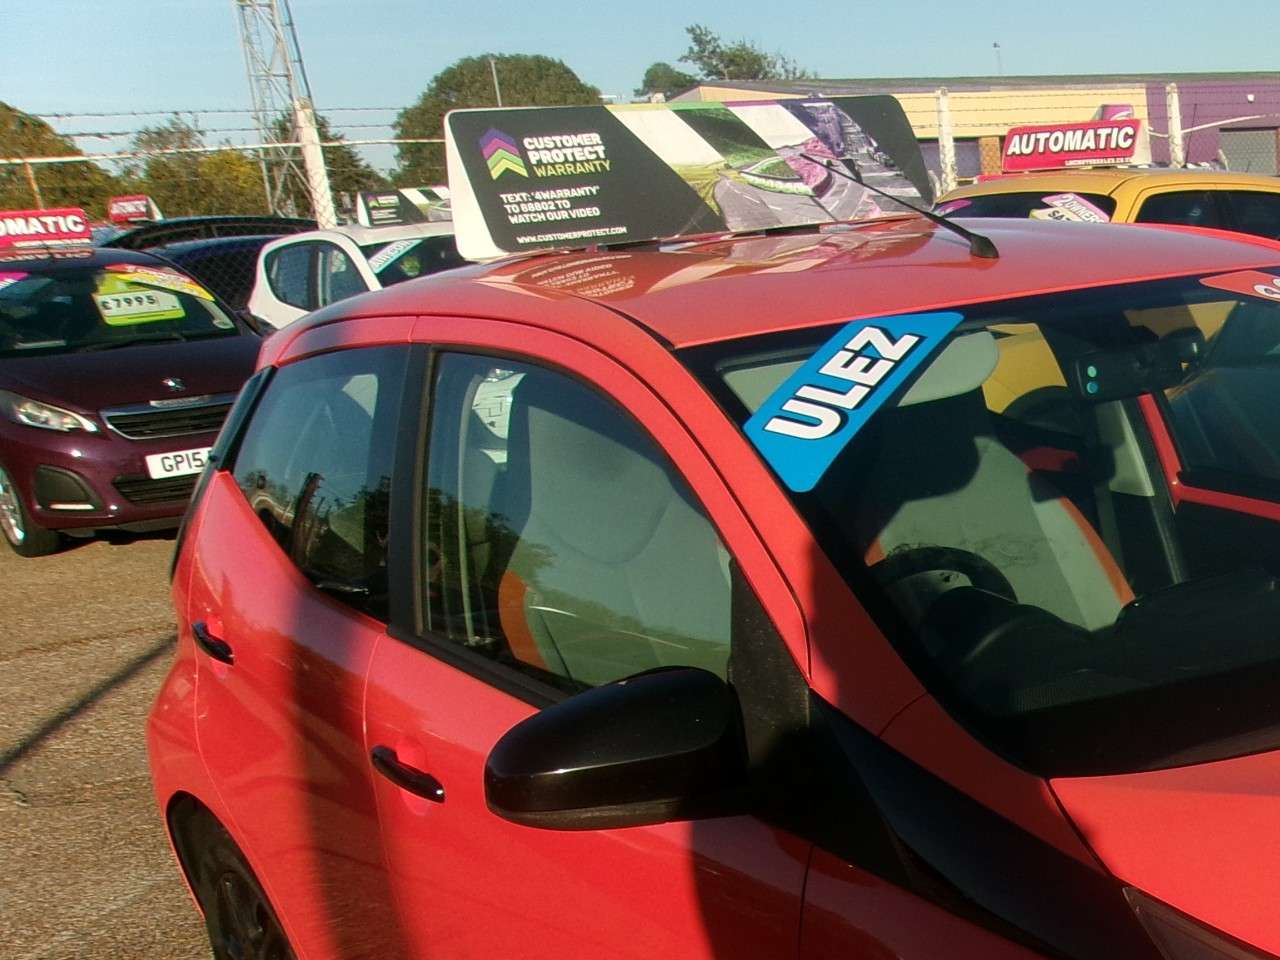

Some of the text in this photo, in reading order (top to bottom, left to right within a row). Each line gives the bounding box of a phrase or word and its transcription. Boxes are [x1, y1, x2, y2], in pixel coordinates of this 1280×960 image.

[523, 133, 603, 150] CUSTOMER
[1007, 126, 1135, 156] AUTOMATIC
[527, 145, 606, 165] PROTECT
[533, 159, 612, 178] WARRANTY
[500, 192, 531, 204] TEXT:
[504, 204, 520, 214] TO
[556, 199, 571, 209] TO
[508, 207, 601, 225] WATCH OUR VIDEO
[101, 294, 156, 311] £7995
[763, 325, 927, 441] ULEZ
[160, 451, 205, 473] GP15
